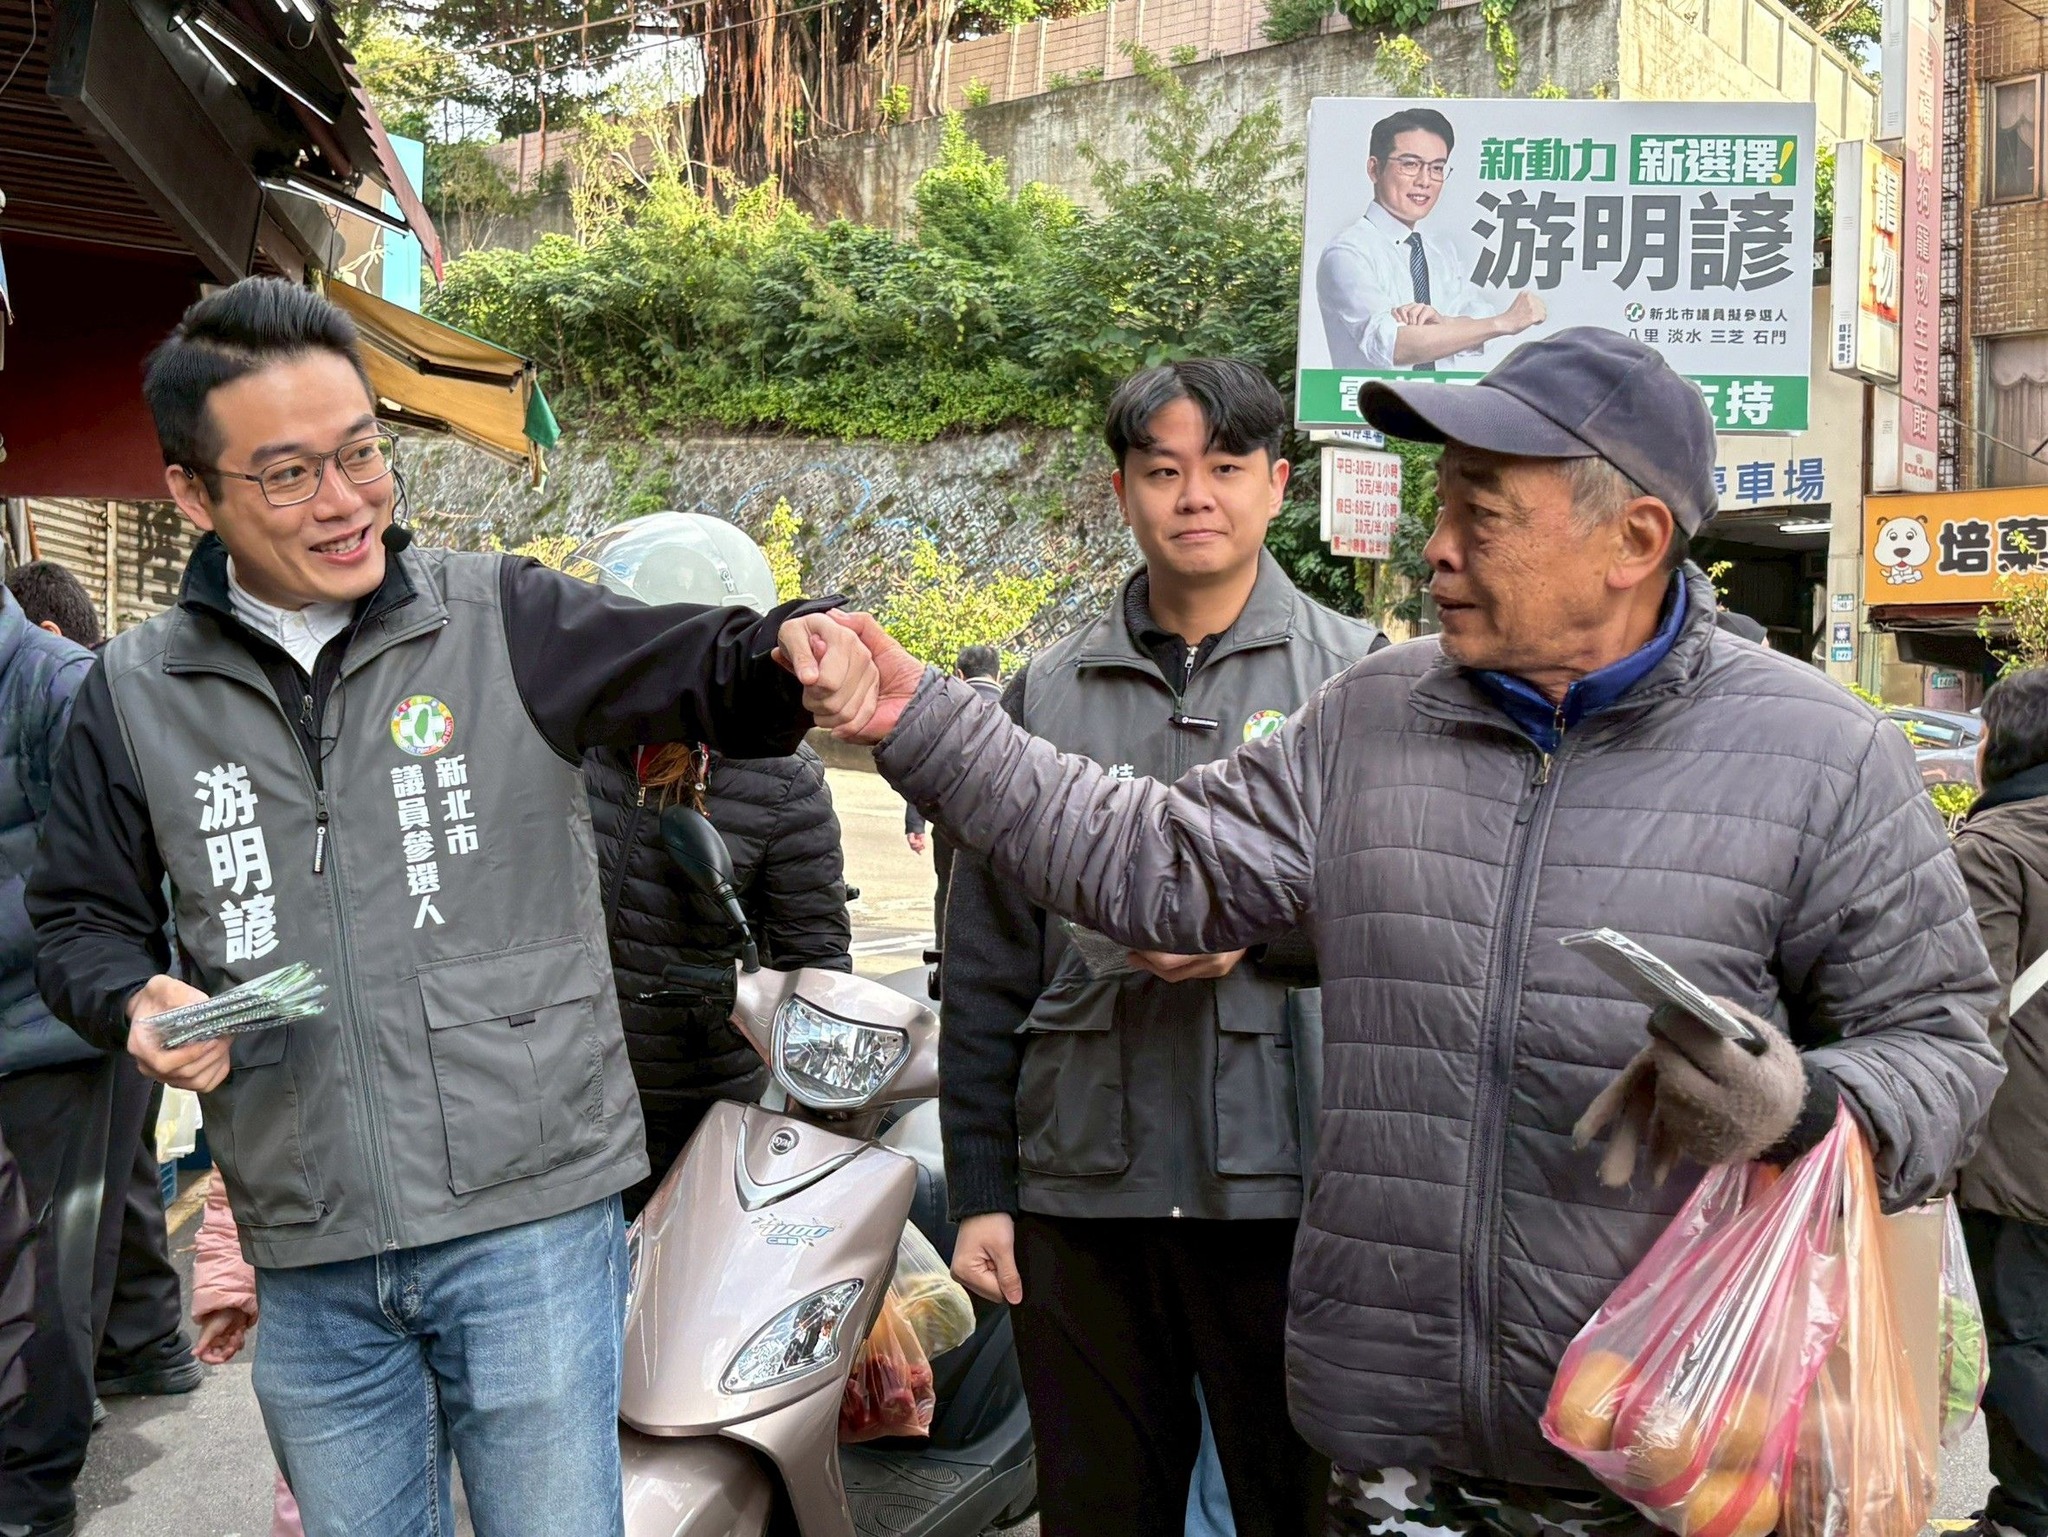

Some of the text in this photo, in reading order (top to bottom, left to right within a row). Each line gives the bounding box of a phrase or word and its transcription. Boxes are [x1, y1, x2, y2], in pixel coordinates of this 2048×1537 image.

[1479, 137, 1617, 182] 新動力
[1470, 190, 1794, 292] 游明諺
[1627, 328, 1787, 345] 八里 淡水 三芝 石門
[1649, 307, 1788, 322] 新北市議員擬參選人
[390, 766, 446, 930] 議員參選人
[435, 754, 480, 856] 新北市
[194, 762, 280, 964] 游明諺
